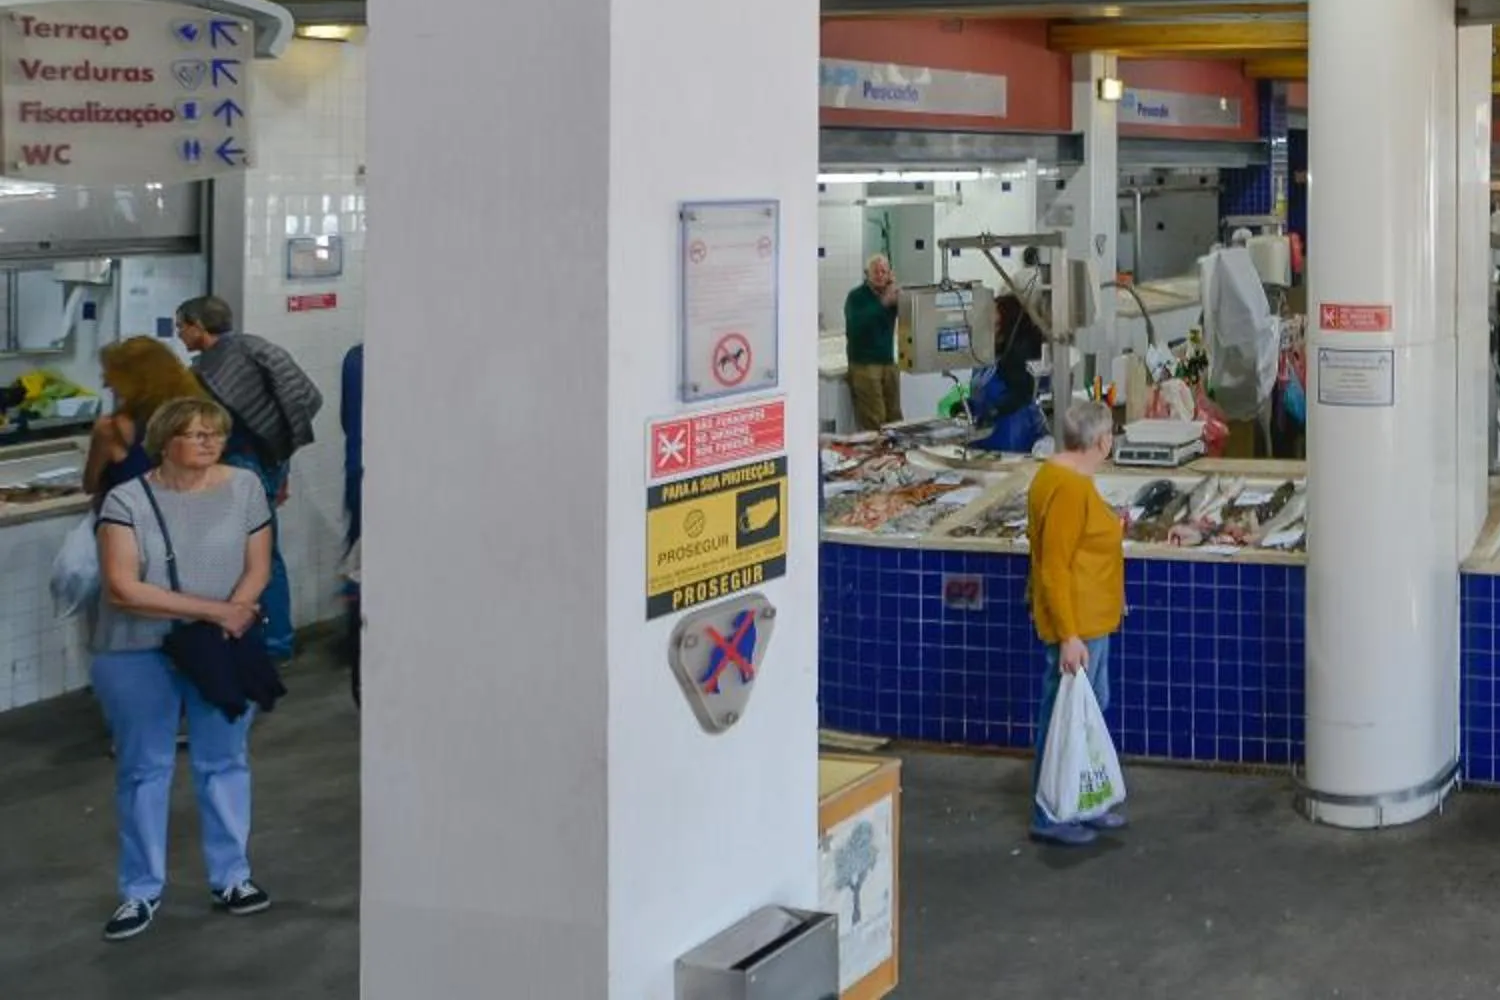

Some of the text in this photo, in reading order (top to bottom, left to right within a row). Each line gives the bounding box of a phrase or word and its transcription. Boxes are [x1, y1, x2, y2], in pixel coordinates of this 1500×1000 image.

[20, 15, 129, 45] Terraço
[19, 58, 154, 83] Verduras
[19, 101, 175, 128] Fiscalização
[21, 144, 72, 166] WC
[662, 482, 692, 501] PARA
[701, 475, 721, 491] SUA
[656, 535, 729, 566] PROSEGUR
[672, 563, 764, 610] PROSEGUR
